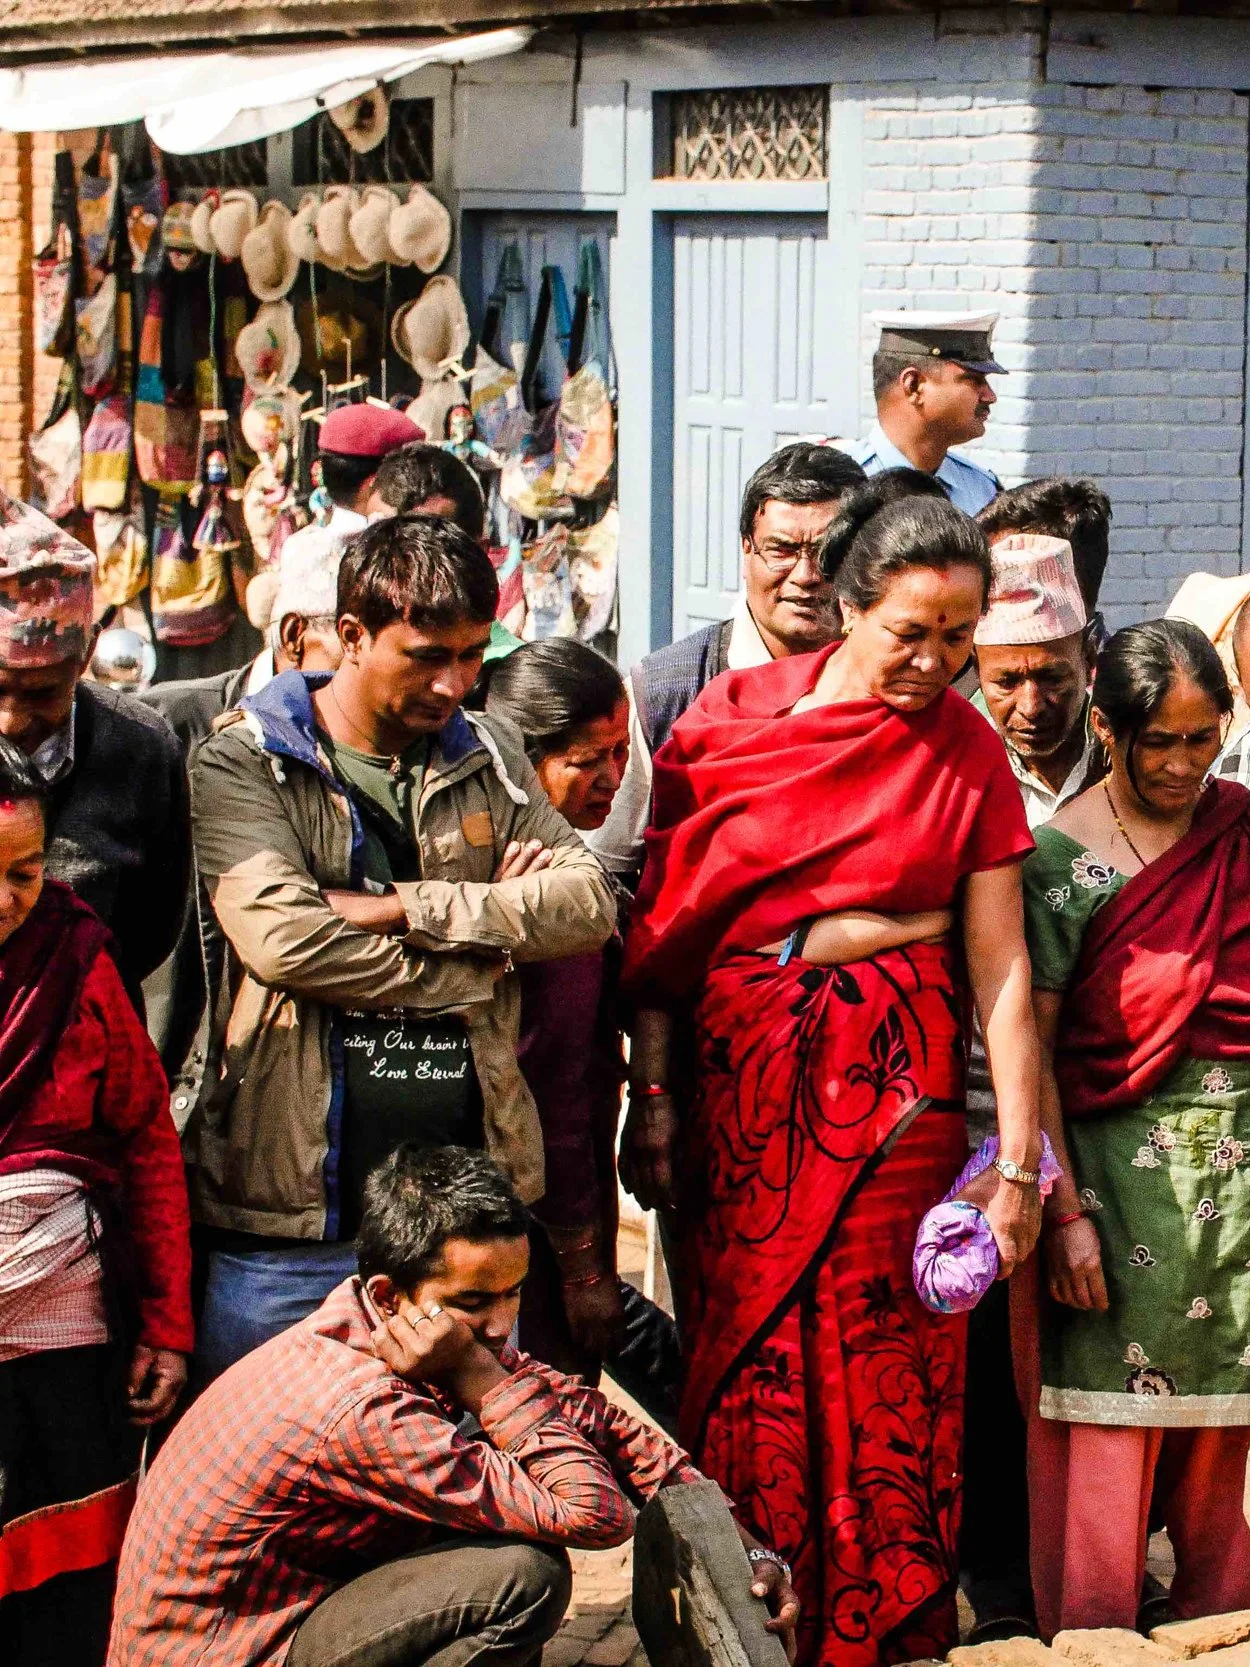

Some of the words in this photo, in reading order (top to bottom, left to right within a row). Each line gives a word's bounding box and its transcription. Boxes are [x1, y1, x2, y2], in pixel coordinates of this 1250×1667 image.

[383, 1030, 416, 1050] Our
[369, 1057, 408, 1079] Love
[415, 1060, 467, 1080] Eternal
